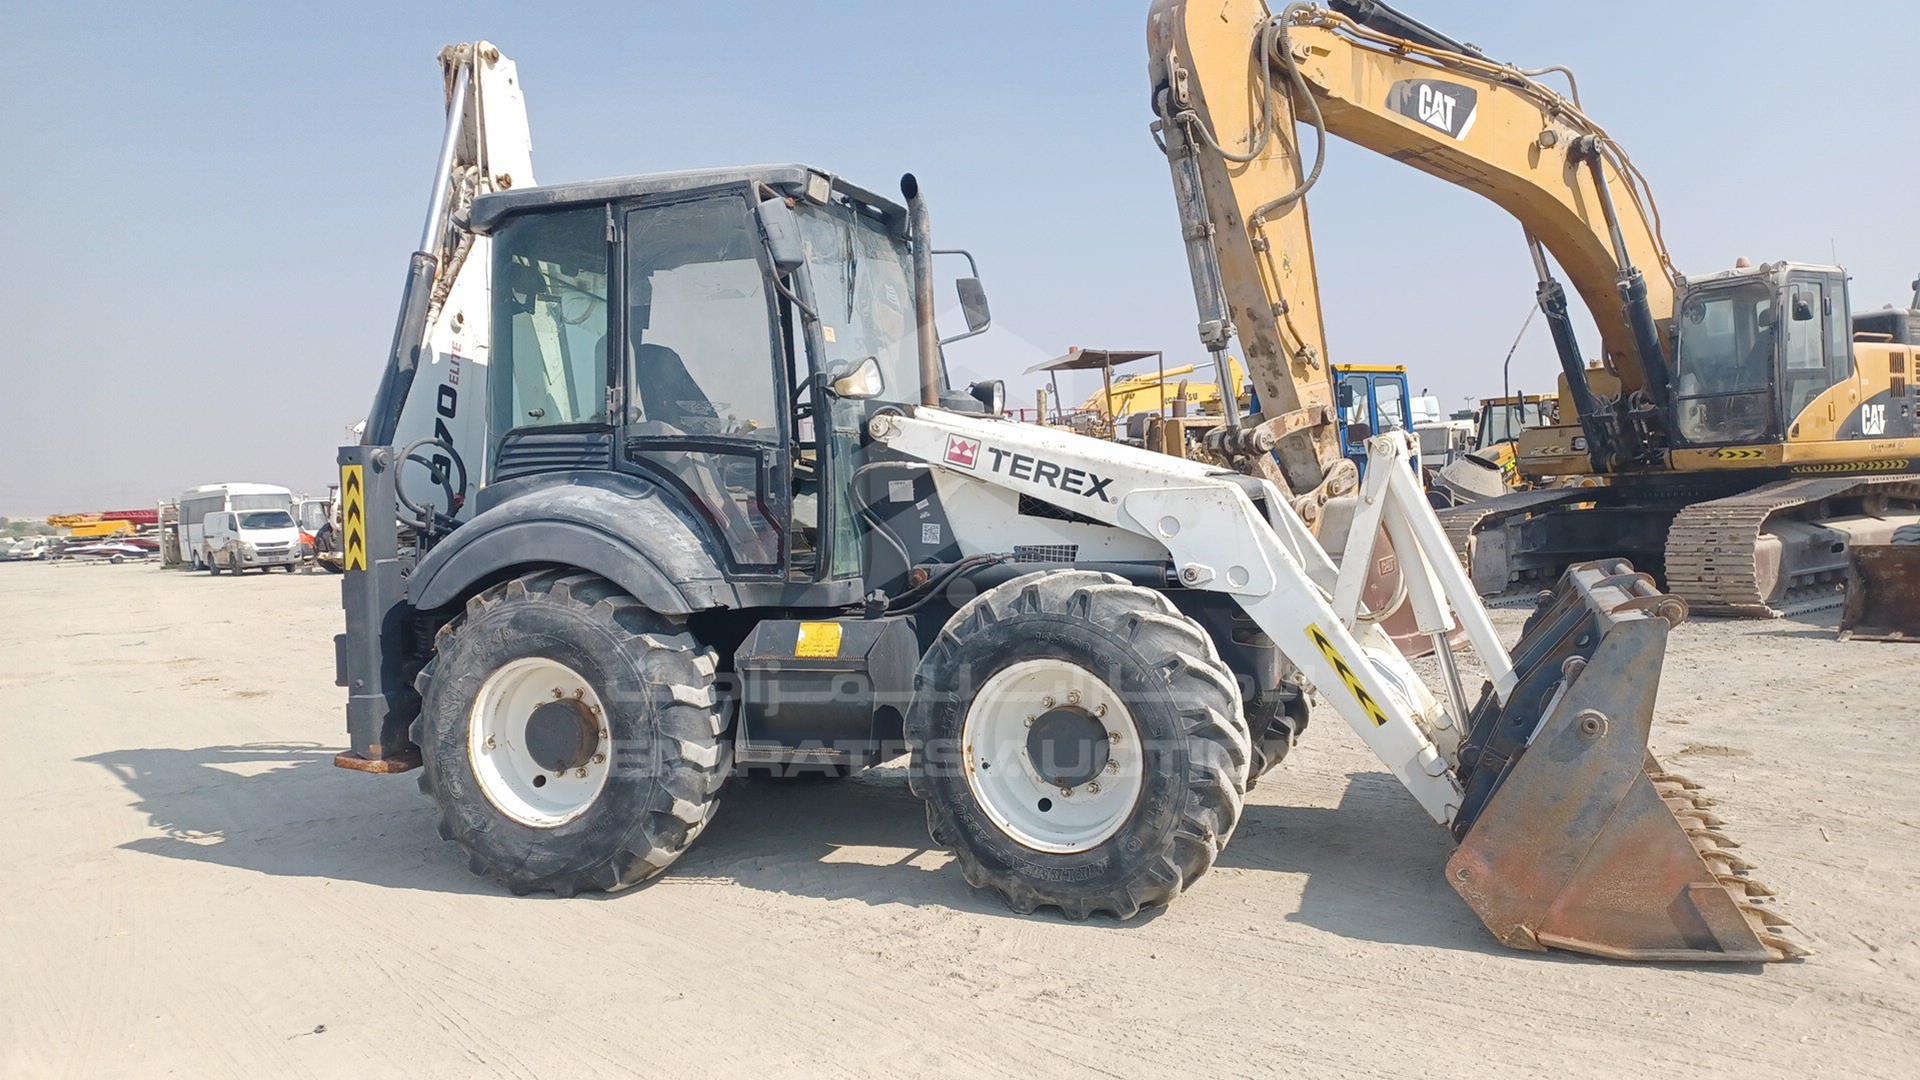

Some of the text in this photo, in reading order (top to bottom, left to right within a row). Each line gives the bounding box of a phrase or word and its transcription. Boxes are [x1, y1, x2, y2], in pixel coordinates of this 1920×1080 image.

[1418, 83, 1456, 133] CAT
[449, 340, 462, 386] ELITE
[1861, 403, 1886, 435] CAT
[988, 447, 1114, 503] TEREX
